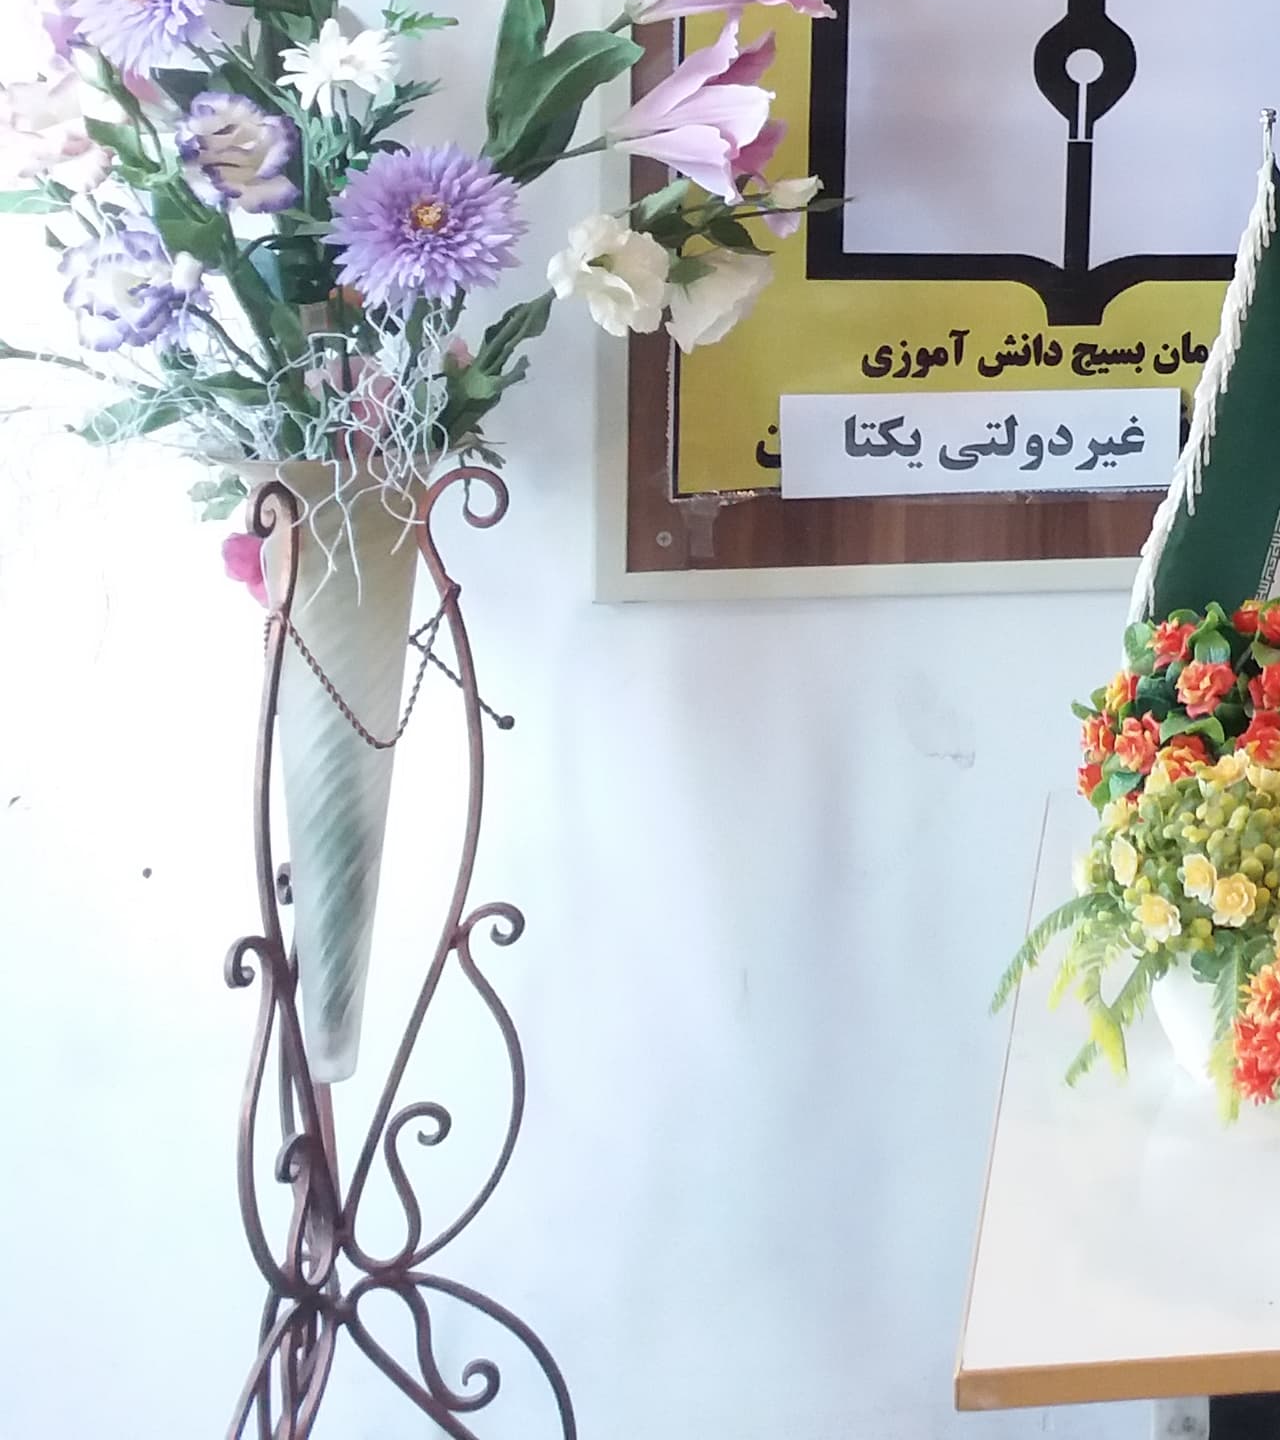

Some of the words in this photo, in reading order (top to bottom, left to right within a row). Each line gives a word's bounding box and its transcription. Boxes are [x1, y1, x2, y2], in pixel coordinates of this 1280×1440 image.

[861, 329, 971, 379] آموزی
[978, 331, 1065, 378] دانش
[1071, 338, 1146, 376] بسیج
[1152, 330, 1210, 375] مان
[843, 413, 924, 470] یکتا
[938, 414, 1148, 472] غیردولتی
